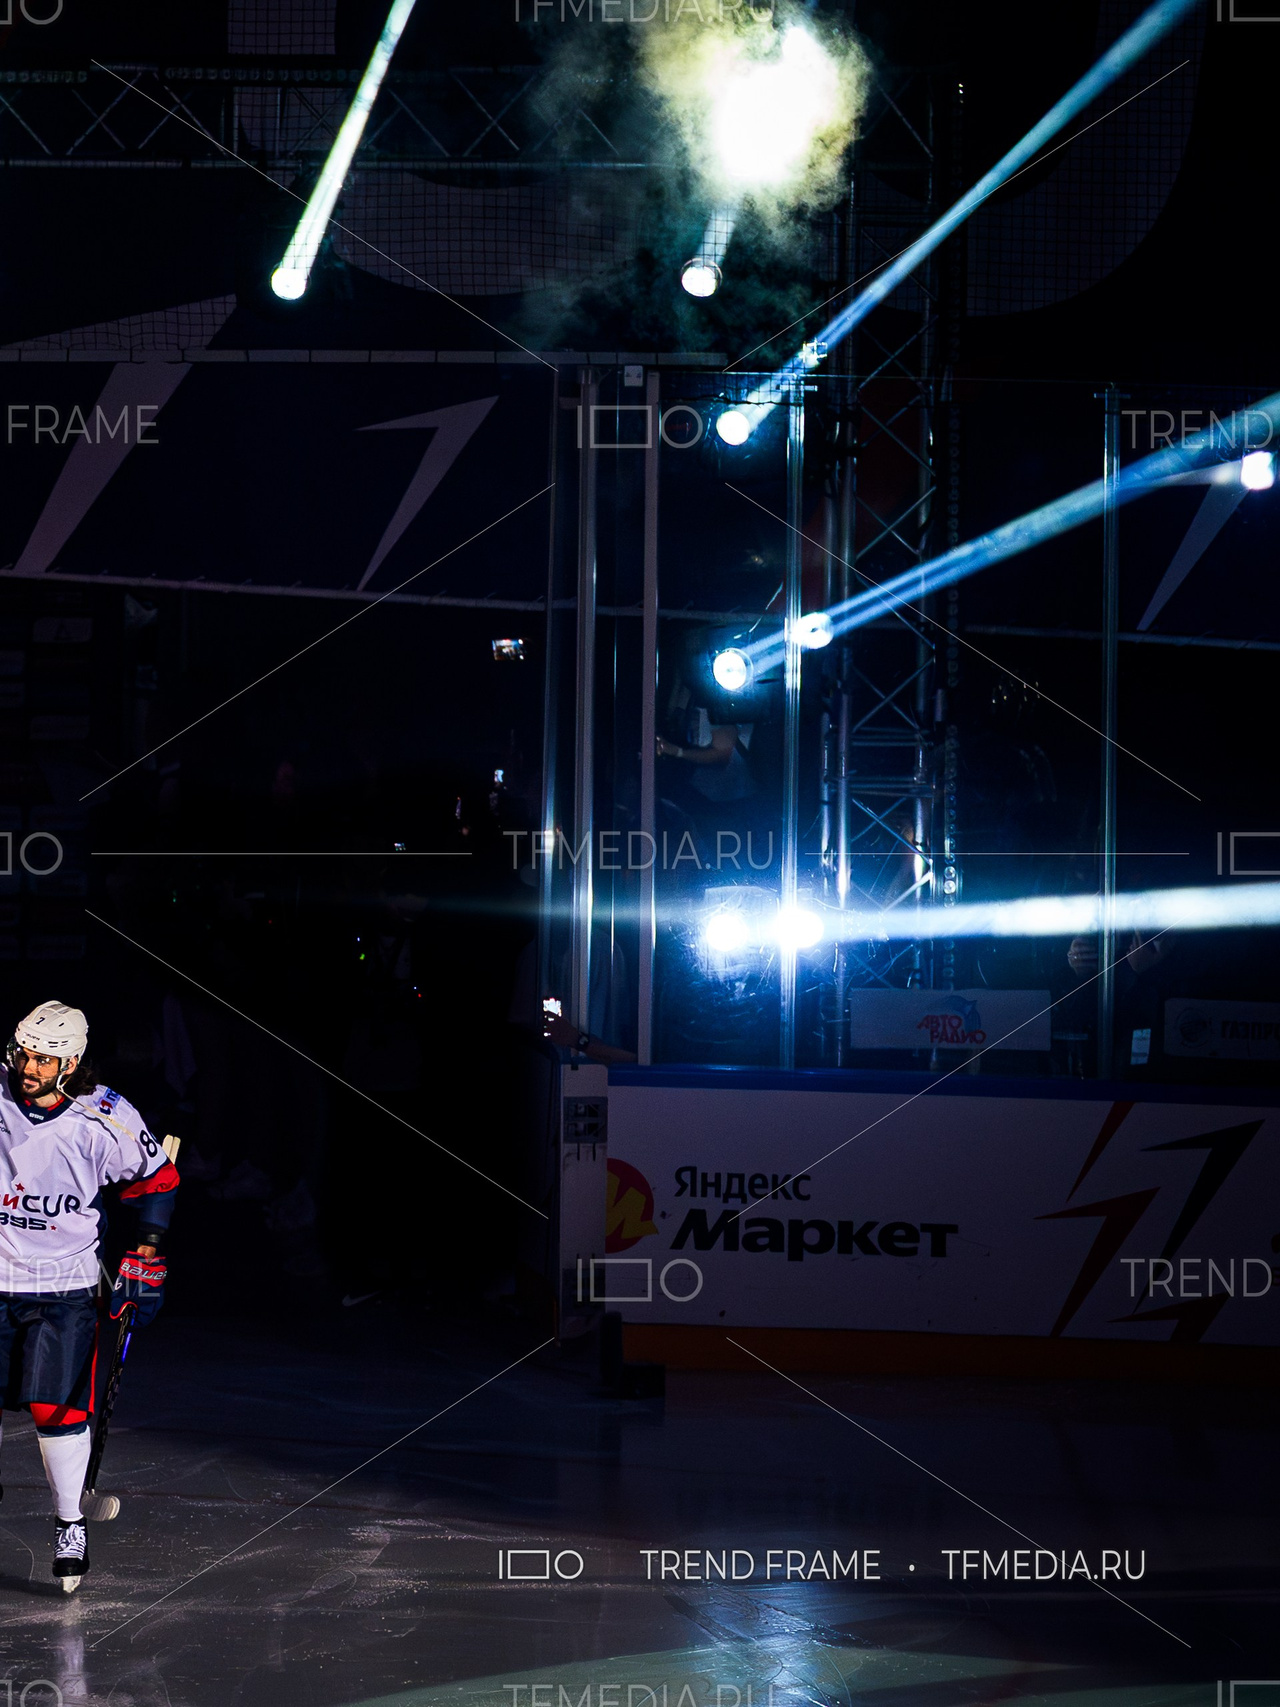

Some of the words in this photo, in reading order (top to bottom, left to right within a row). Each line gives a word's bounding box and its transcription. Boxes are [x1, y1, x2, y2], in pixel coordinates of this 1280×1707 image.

[917, 1014, 963, 1030] АВТО
[930, 1028, 987, 1045] РАДИО
[674, 1166, 812, 1204] Яндекс
[669, 1208, 959, 1262] Маркет
